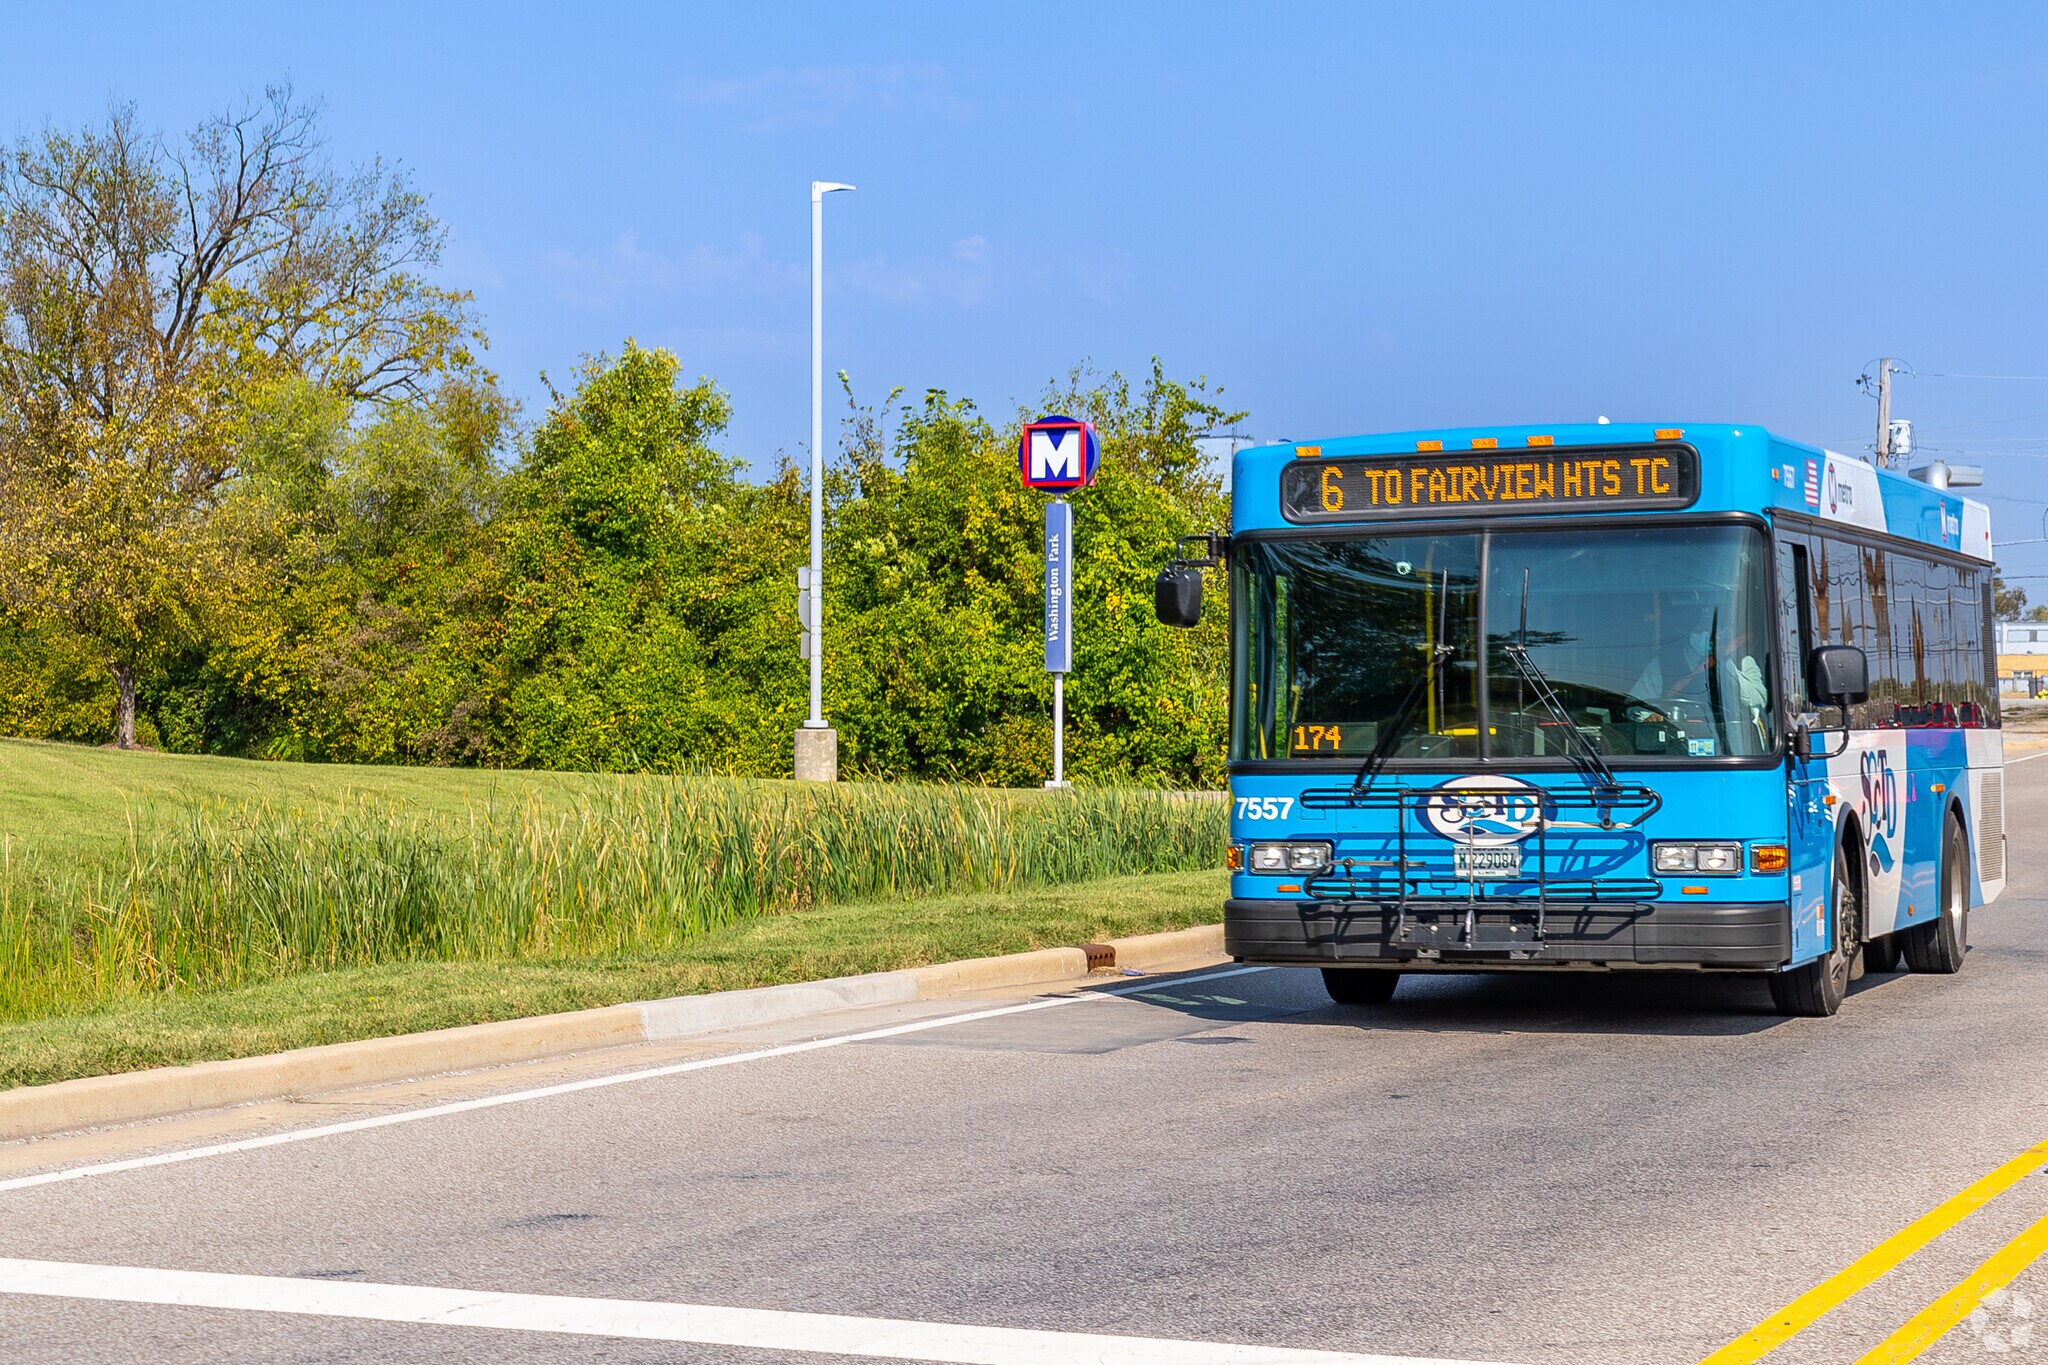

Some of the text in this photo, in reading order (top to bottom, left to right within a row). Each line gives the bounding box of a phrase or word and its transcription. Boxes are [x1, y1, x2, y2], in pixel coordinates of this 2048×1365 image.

[1031, 431, 1080, 479] M
[1321, 457, 1670, 511] 6 TO FAIRVIEW HTS TC
[1047, 533, 1062, 642] Washington Park
[1294, 725, 1341, 750] 174
[1236, 797, 1295, 820] 7557
[1472, 853, 1517, 869] 229084
